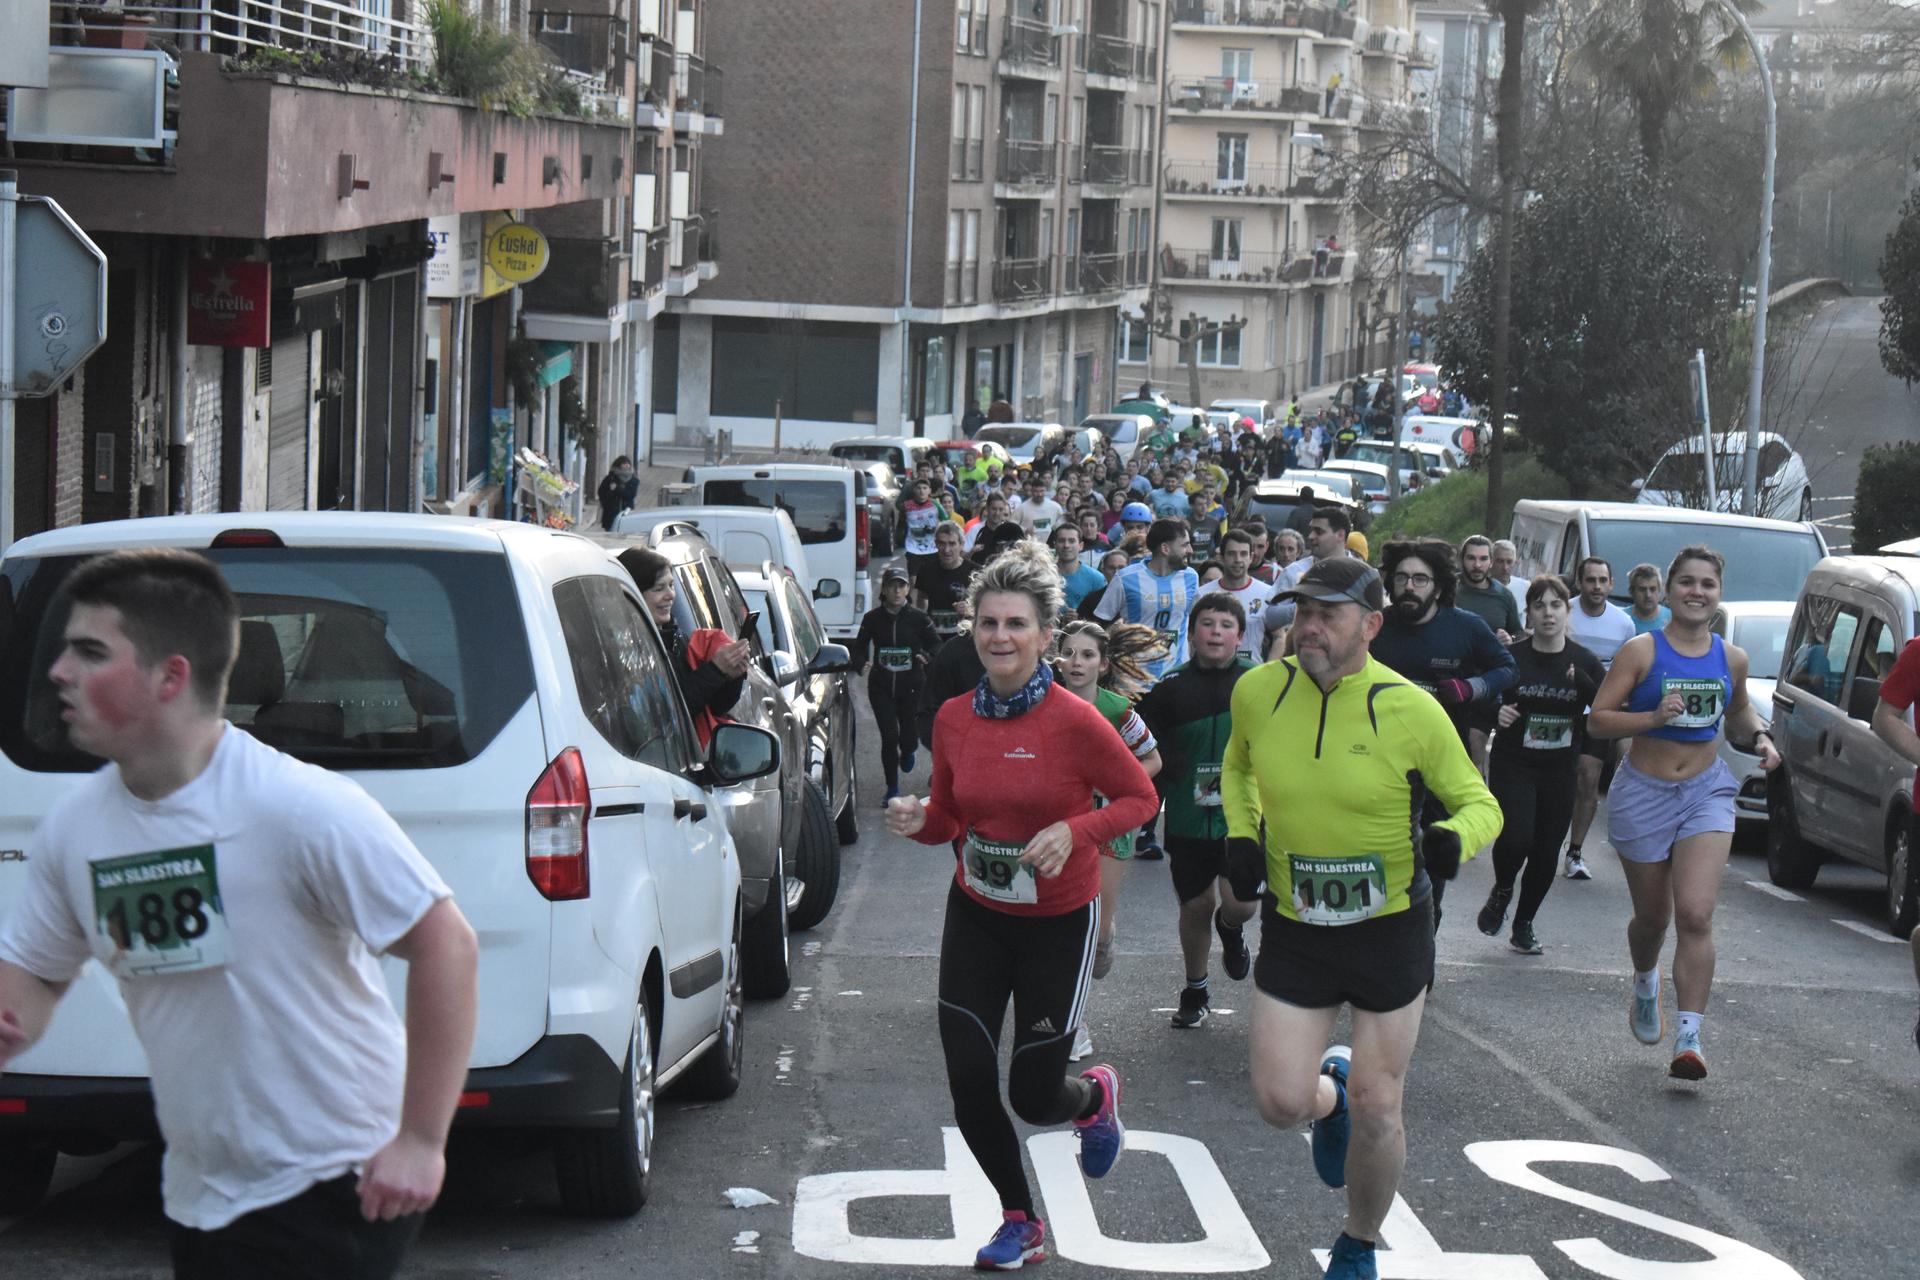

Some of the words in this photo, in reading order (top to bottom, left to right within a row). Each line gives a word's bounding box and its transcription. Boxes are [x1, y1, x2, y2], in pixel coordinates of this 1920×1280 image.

[428, 232, 450, 244] AT
[499, 234, 539, 256] Euskal
[506, 257, 528, 272] Pizza
[1155, 610, 1171, 630] 10
[1679, 694, 1717, 715] 81
[98, 869, 124, 888] SAN
[124, 858, 206, 883] SILBESTREA
[1294, 861, 1313, 873] SAN
[1314, 861, 1376, 874] SILBESTREA
[1299, 876, 1372, 910] 101
[107, 886, 209, 951] 188
